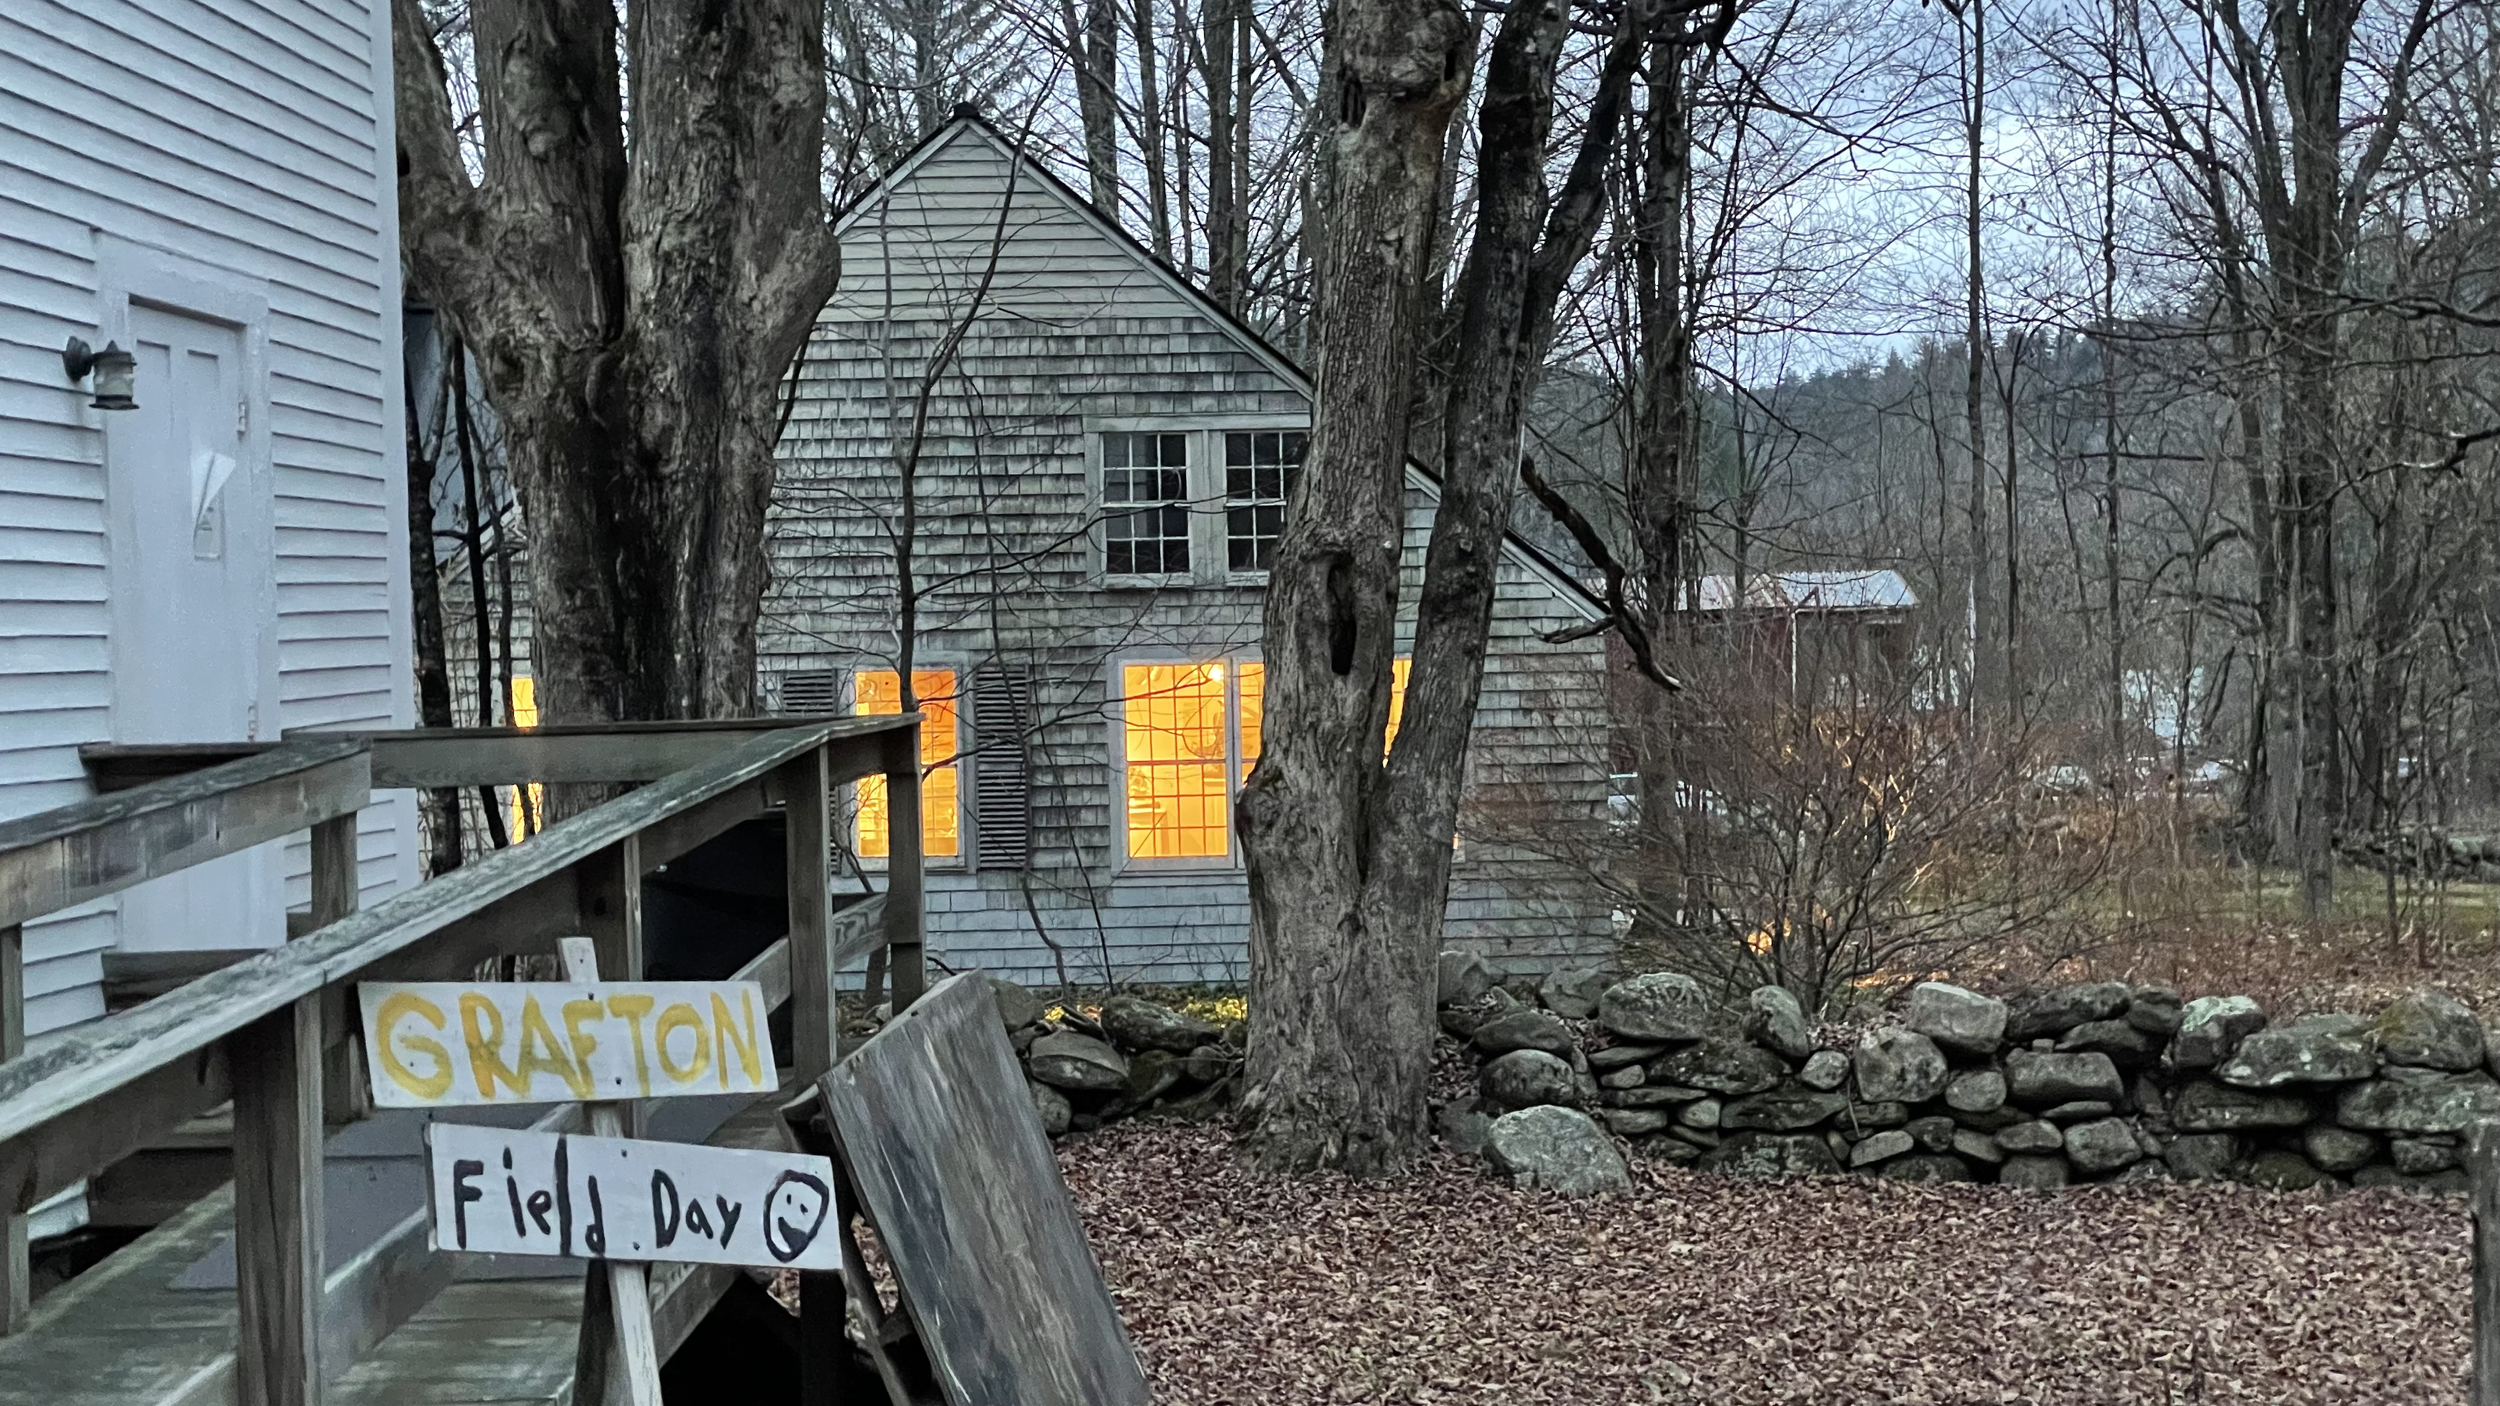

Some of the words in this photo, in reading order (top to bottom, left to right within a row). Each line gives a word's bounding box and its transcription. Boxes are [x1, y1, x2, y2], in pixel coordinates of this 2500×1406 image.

[376, 988, 763, 1099] GRAFTON
[453, 1135, 606, 1257] Field
[652, 1168, 742, 1249] Day
